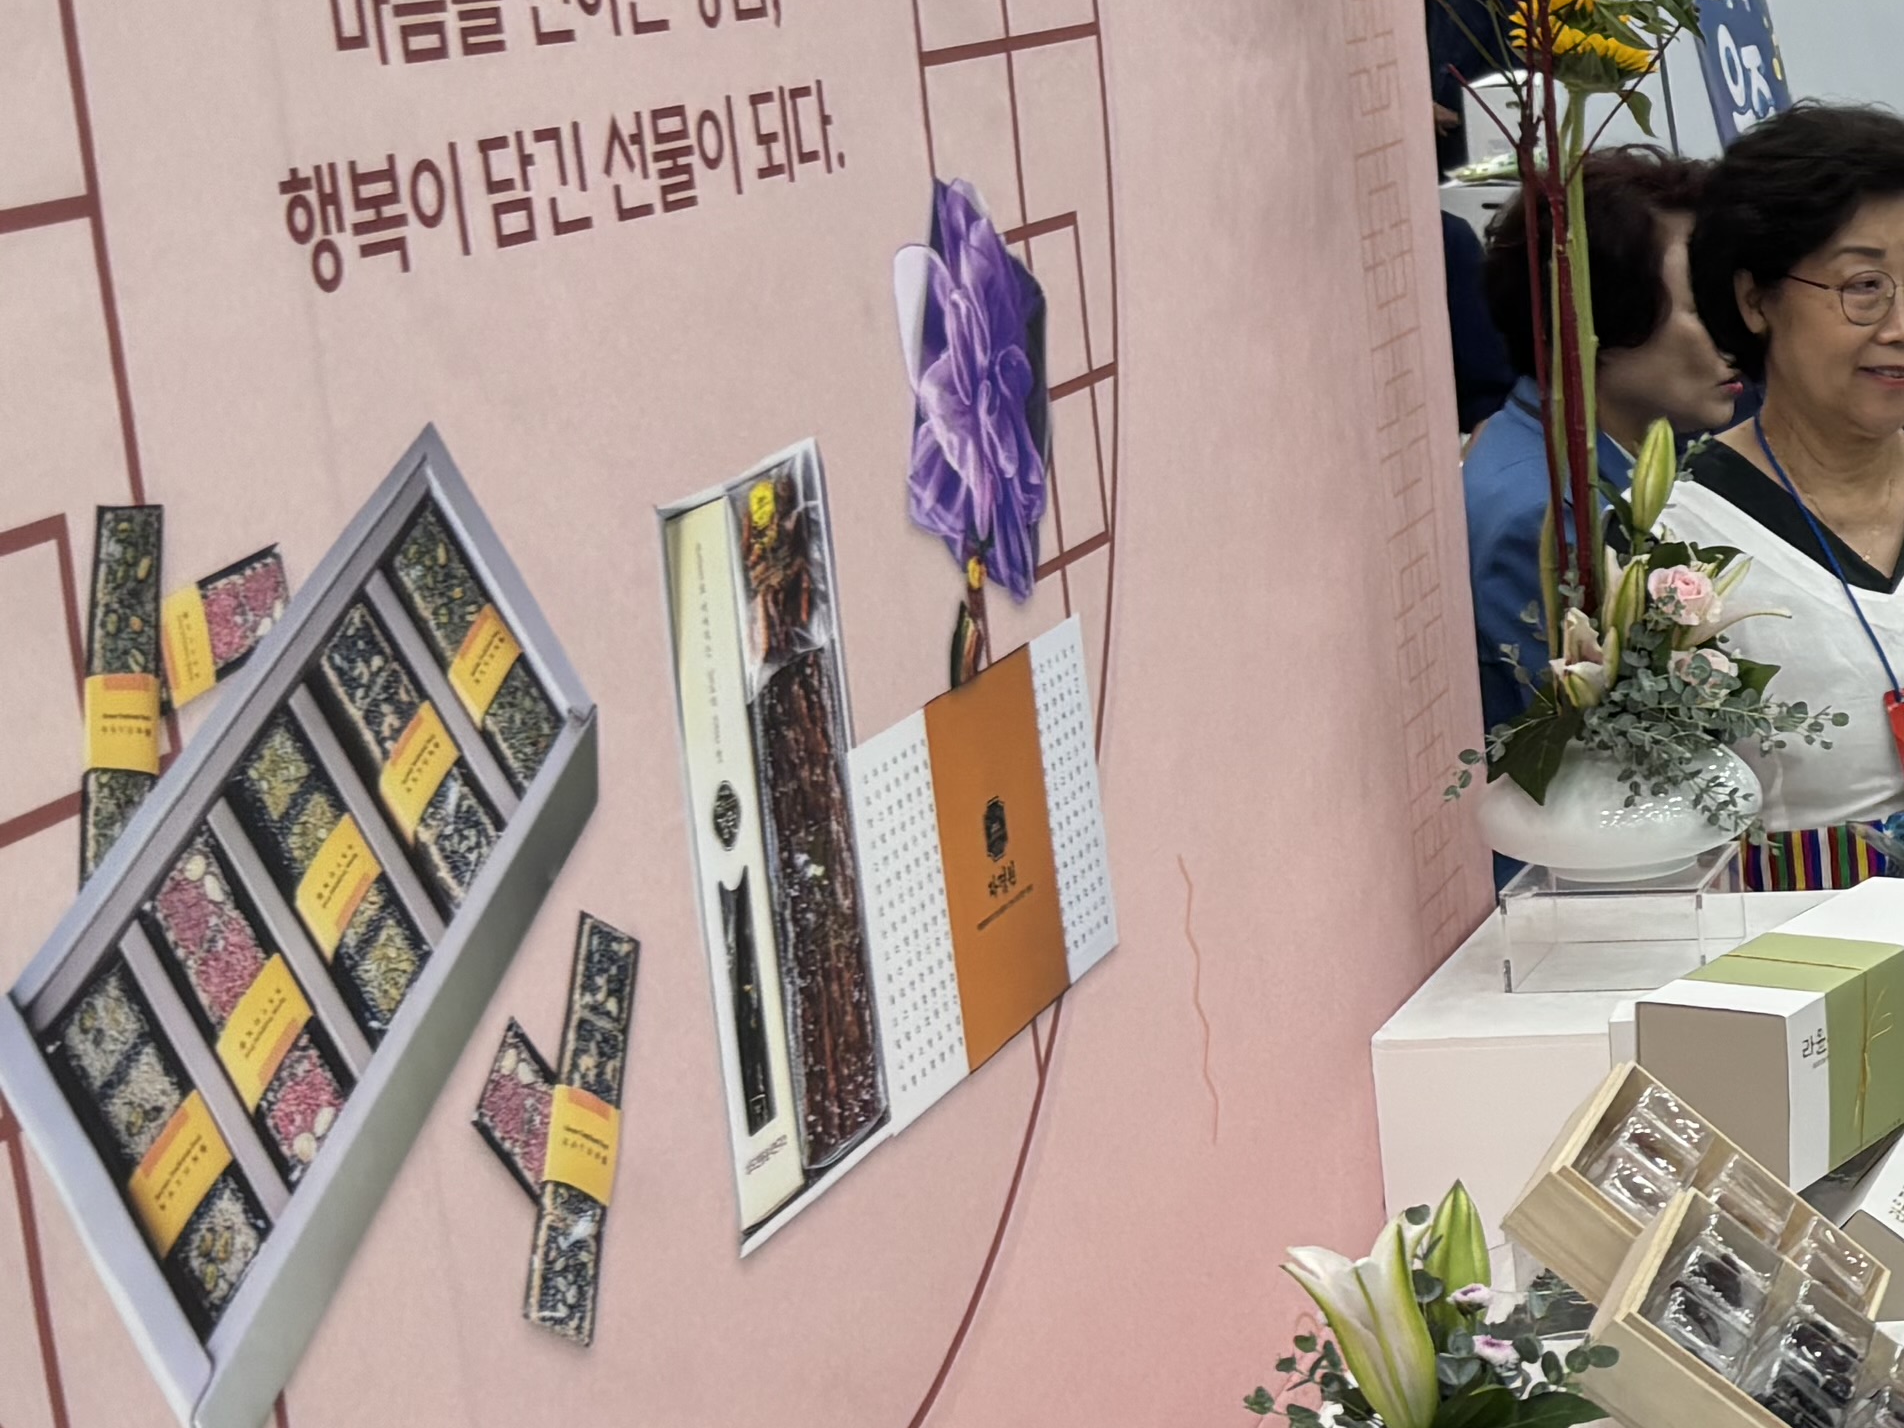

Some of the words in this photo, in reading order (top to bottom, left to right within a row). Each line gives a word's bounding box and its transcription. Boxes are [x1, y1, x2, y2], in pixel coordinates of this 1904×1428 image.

[278, 154, 474, 294] 행복이
[477, 118, 594, 253] 담긴
[600, 92, 744, 223] 선물이
[746, 79, 847, 184] 되다.
